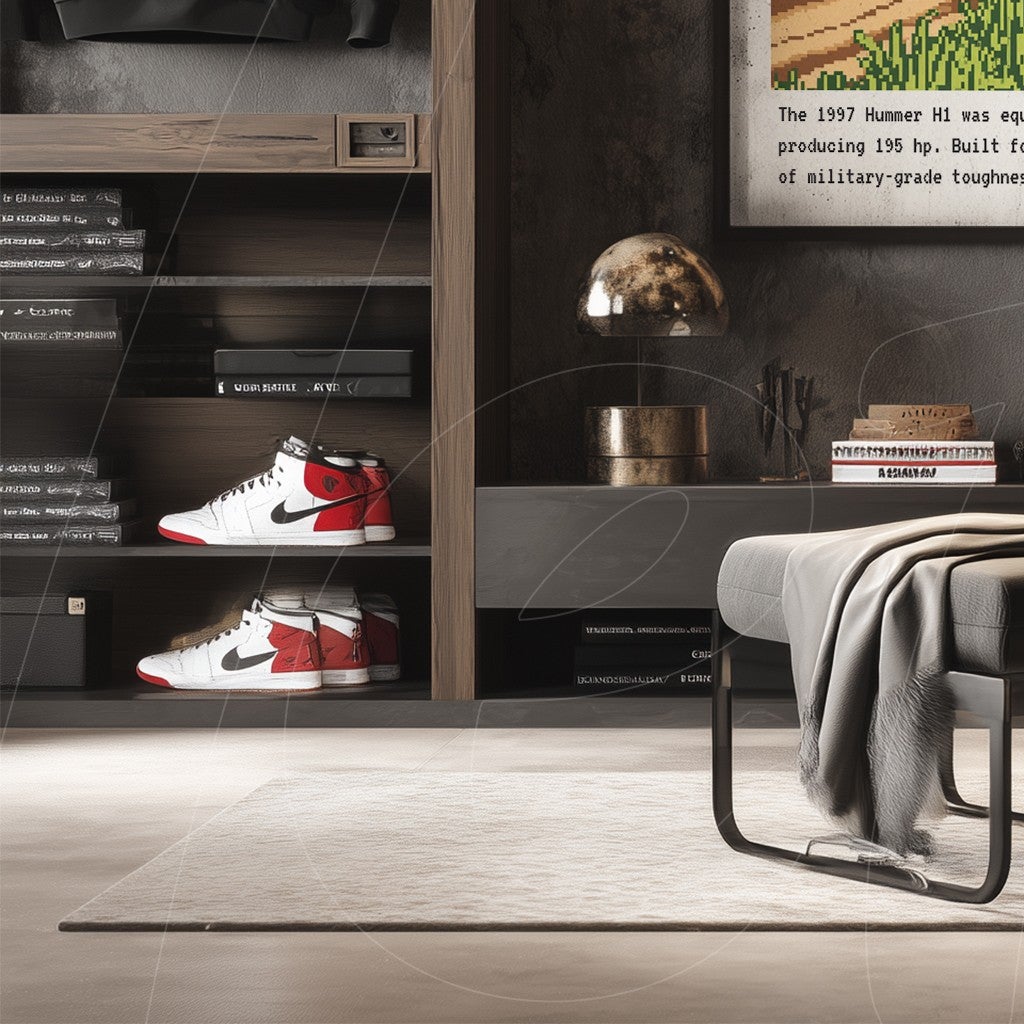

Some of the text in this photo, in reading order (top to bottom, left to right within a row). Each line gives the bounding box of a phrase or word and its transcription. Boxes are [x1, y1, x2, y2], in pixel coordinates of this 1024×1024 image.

[778, 106, 807, 122] The
[818, 106, 855, 122] 1997
[865, 106, 923, 122] Hummer
[932, 106, 951, 122] H1
[961, 111, 990, 122] was
[778, 137, 865, 157] producing
[876, 137, 904, 153] 195
[913, 137, 942, 157] hp.
[952, 137, 999, 154] Built
[778, 168, 797, 184] of
[807, 168, 942, 188] military-grade
